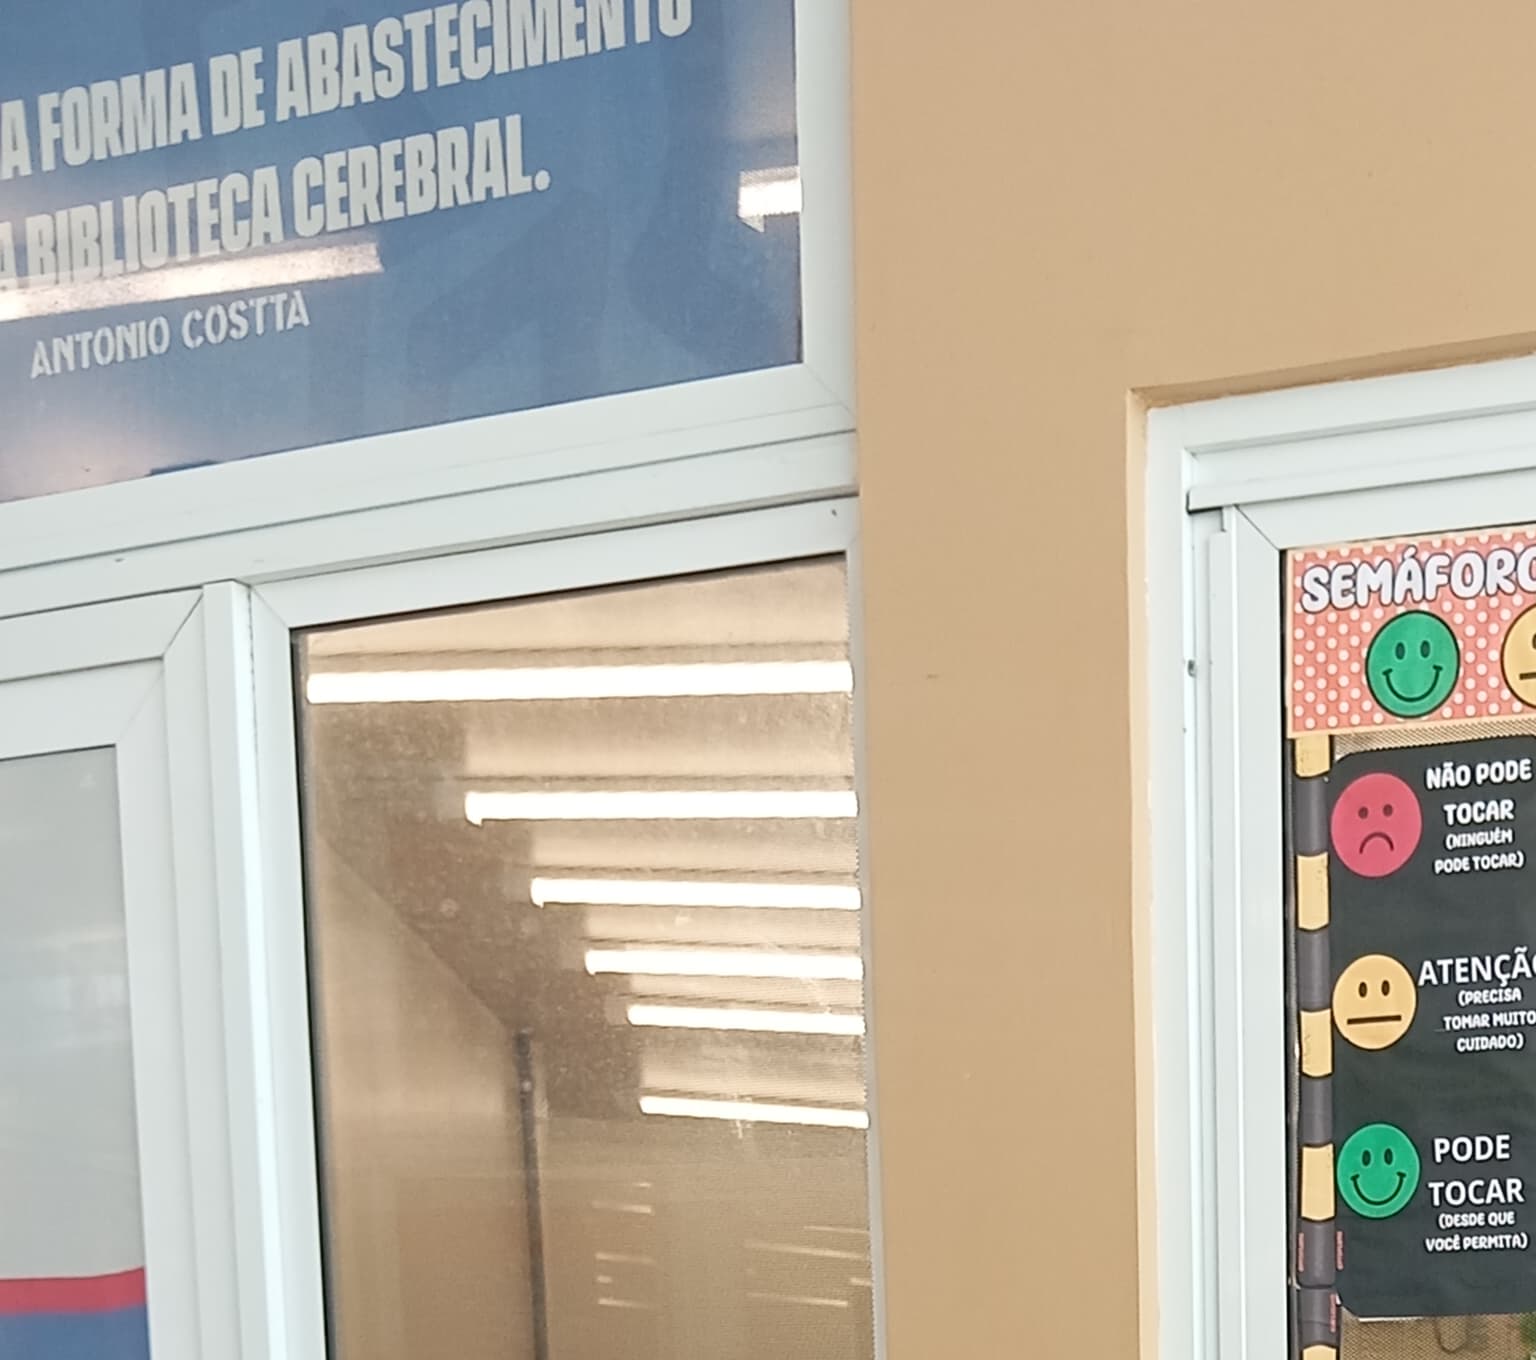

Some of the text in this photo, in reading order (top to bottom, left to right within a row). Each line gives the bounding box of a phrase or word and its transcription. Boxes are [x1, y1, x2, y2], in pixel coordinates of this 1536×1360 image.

[38, 62, 202, 172] FORMA
[209, 47, 265, 135] DE
[25, 165, 284, 285] BIBLIOTECA
[292, 113, 551, 238] CEREBRAL.
[30, 290, 311, 380] ANTONIO COSTTA
[1425, 758, 1533, 790] NÃO PODE
[1443, 799, 1515, 826] TOCAR
[1445, 827, 1514, 850] (NINGUÉM
[1434, 851, 1525, 875] PODE TOCAR)
[1458, 987, 1522, 1007] (PRECISA
[1443, 1013, 1491, 1031] TOMAR
[1456, 1032, 1525, 1053] CUIDADO)
[1433, 1134, 1512, 1164] PODE
[1427, 1178, 1525, 1207] TOCAR
[1438, 1211, 1516, 1230] (DESDE QUE
[1425, 1232, 1528, 1253] VOCÊ PERMITA)
